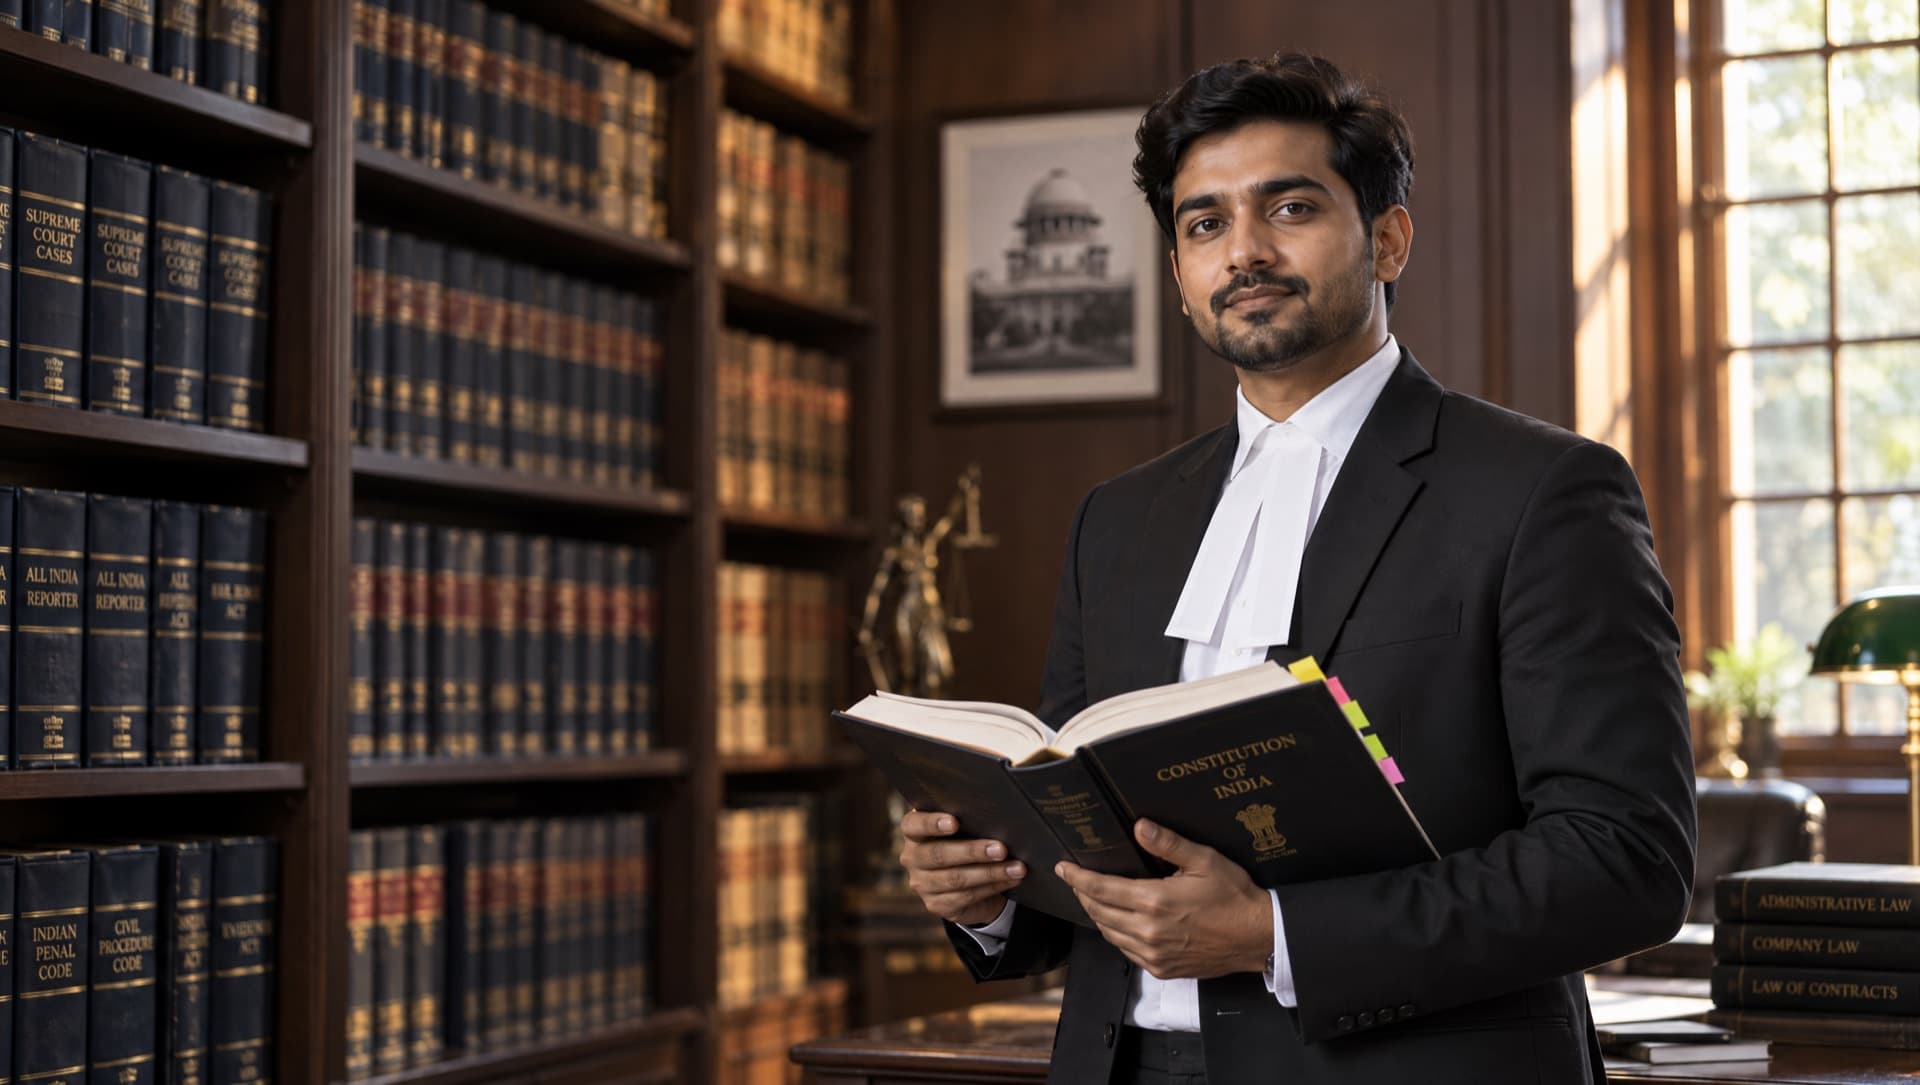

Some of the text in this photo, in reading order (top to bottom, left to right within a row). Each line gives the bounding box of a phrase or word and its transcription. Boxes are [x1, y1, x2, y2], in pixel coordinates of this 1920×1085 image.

[26, 208, 81, 233] SUPREME
[33, 227, 76, 248] COURT
[37, 245, 73, 265] CASES
[103, 241, 142, 262] COURT
[106, 259, 139, 278] CASES
[25, 567, 47, 583] ALL
[49, 567, 79, 585] INDIA
[96, 571, 145, 590] ALL INDIA
[27, 590, 79, 609] REPORTER
[95, 593, 145, 612] REPORTER
[1156, 734, 1297, 782] CONSTITUTION
[1223, 763, 1247, 780] OF
[1213, 774, 1273, 800] INDIA
[1759, 895, 1912, 913] ADMINISTRATIVE LAW
[32, 924, 77, 942] INDIAN
[114, 918, 142, 935] CIVIL
[36, 943, 76, 961] PENAL
[1752, 937, 1859, 954] COMPANY LAW
[38, 962, 73, 981] CODE
[113, 955, 143, 973] CODE
[1752, 979, 1898, 999] LAW OF CONTRACTS
